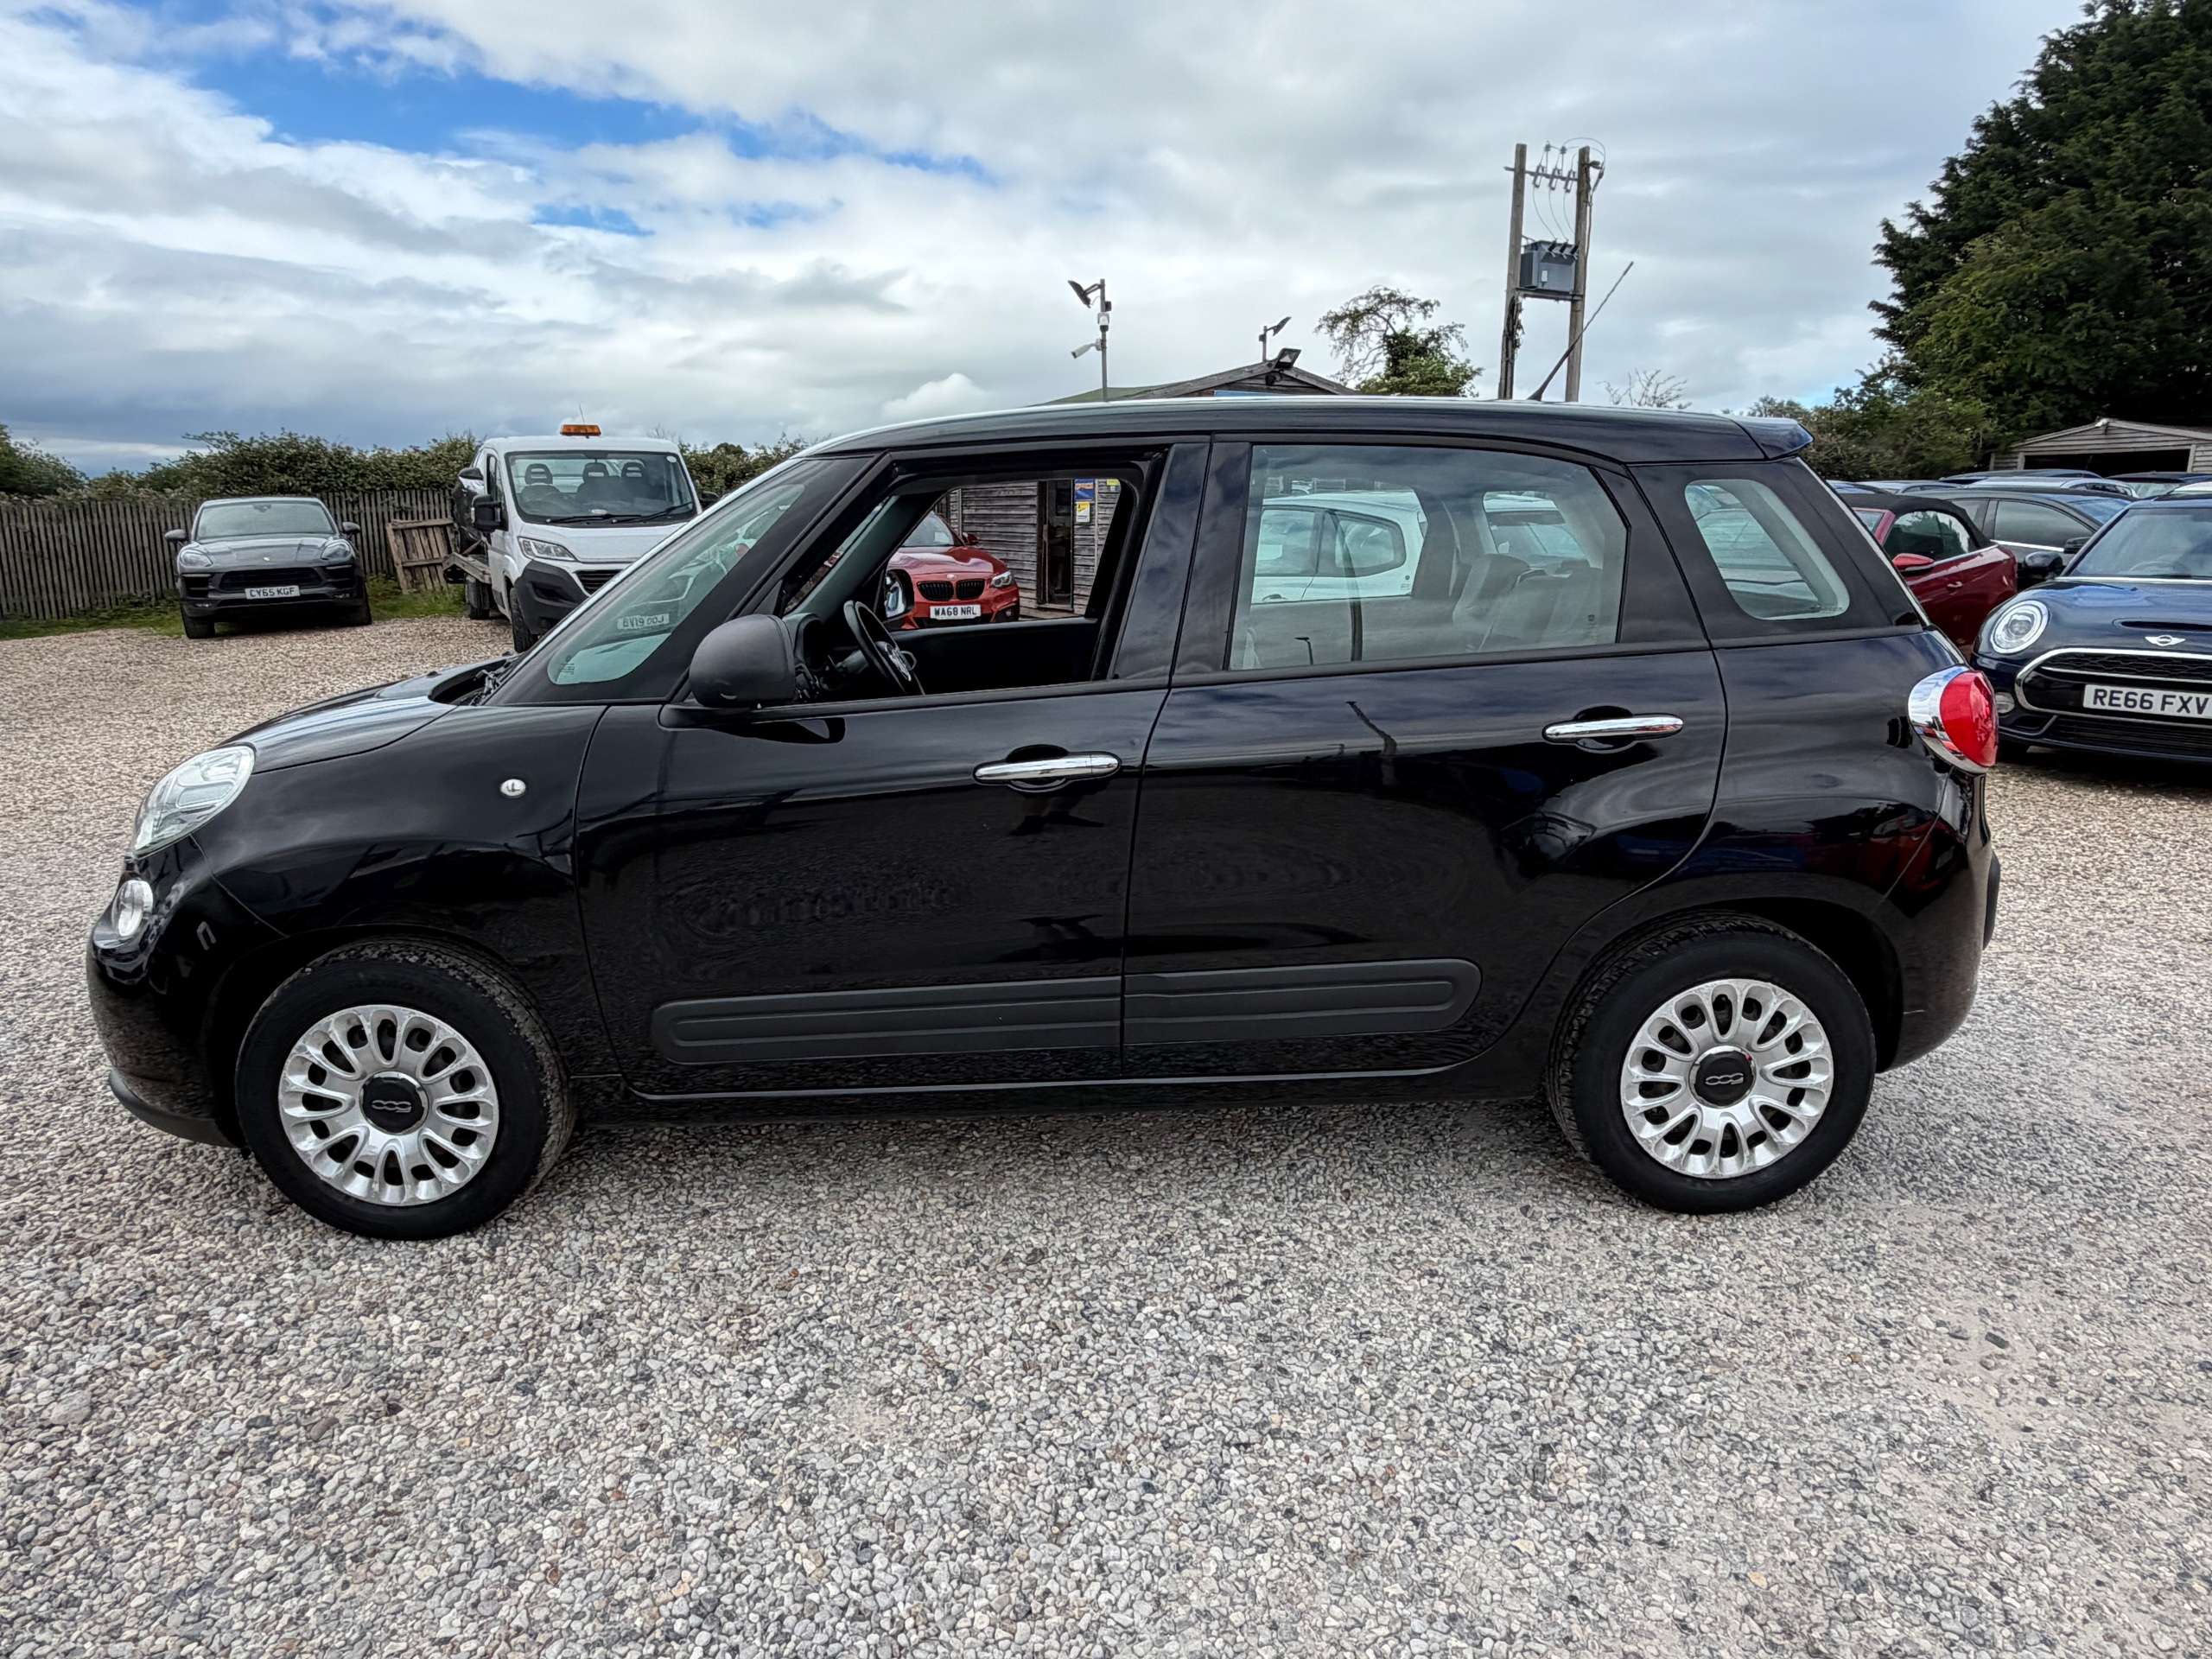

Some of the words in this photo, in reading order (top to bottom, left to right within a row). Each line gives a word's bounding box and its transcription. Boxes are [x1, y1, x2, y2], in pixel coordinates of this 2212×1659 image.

[249, 588, 276, 598] CY65
[276, 587, 296, 595] KGF
[934, 607, 958, 616] WA68
[960, 606, 977, 616] NRL
[2092, 688, 2155, 710] RE66
[2160, 694, 2209, 715] FXV
